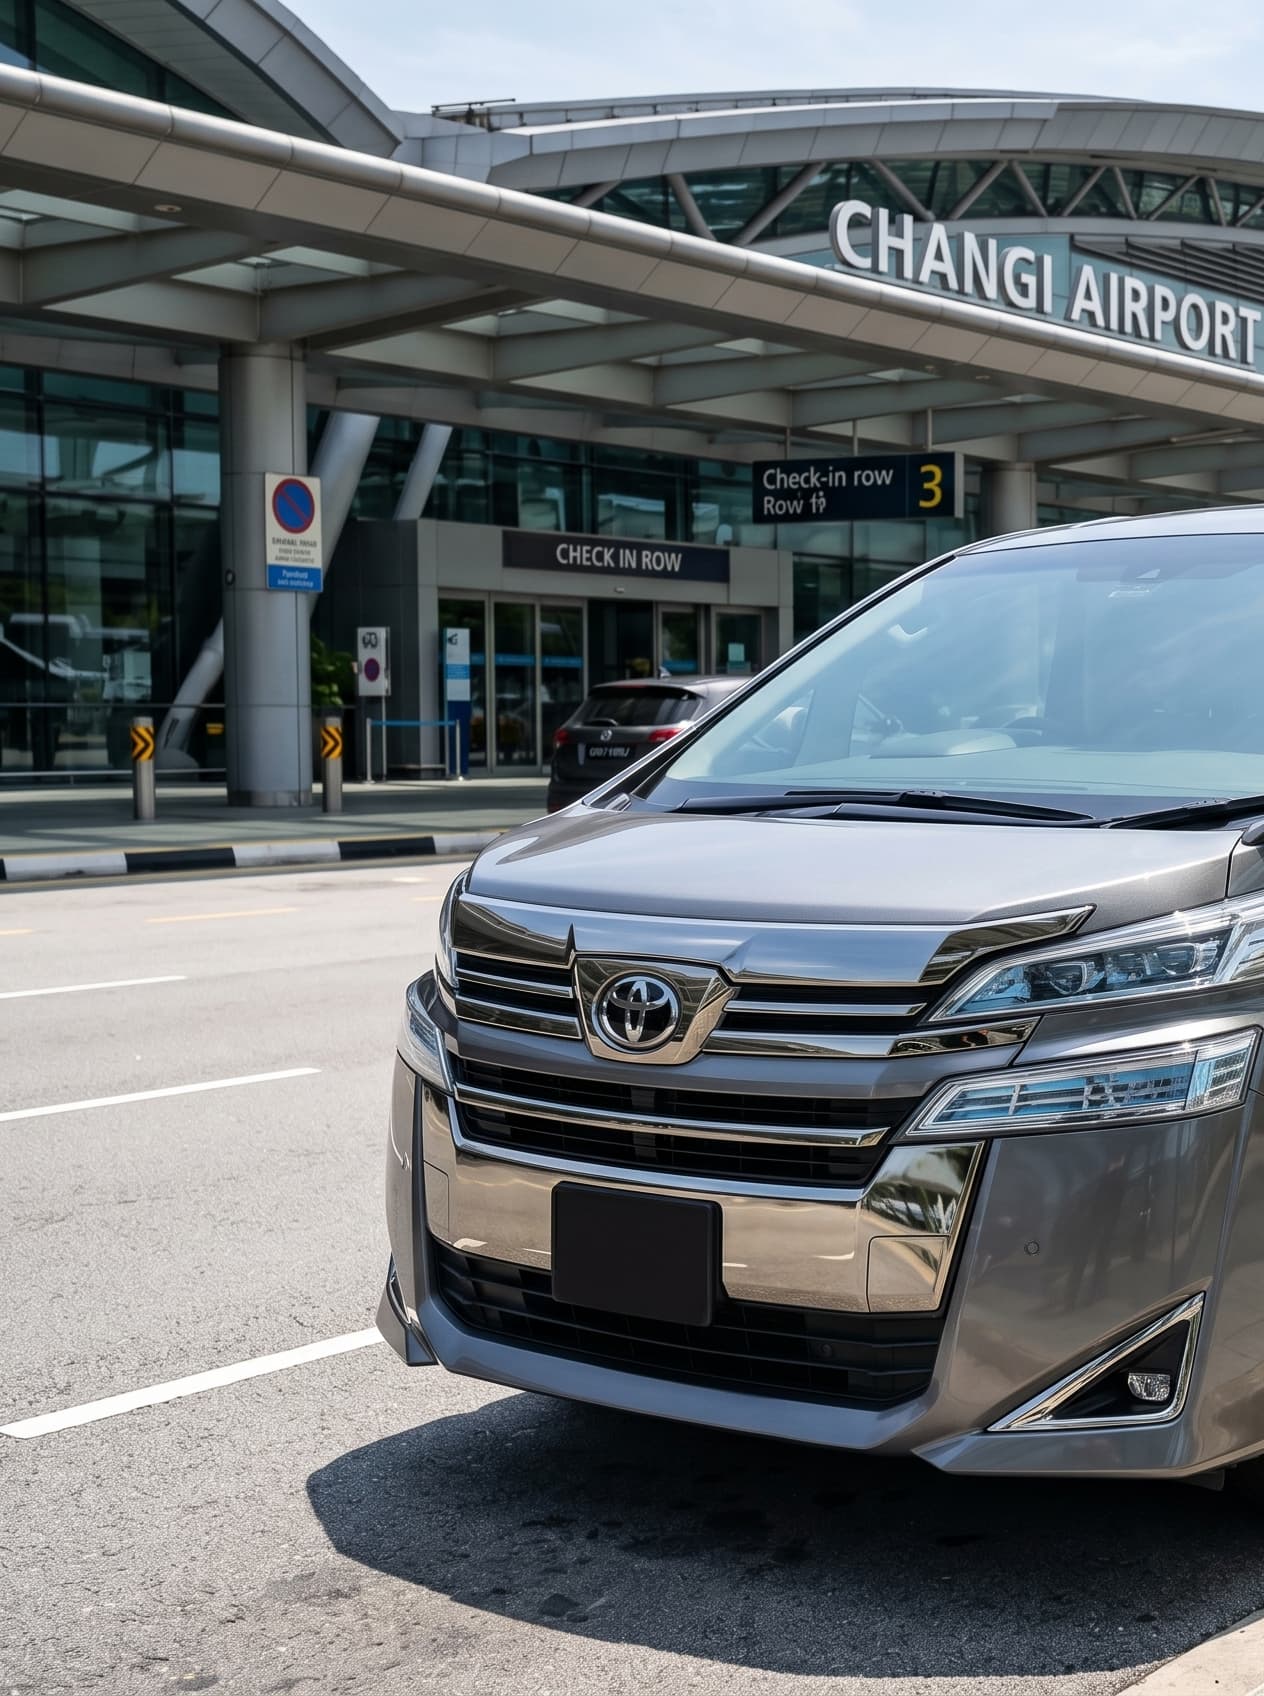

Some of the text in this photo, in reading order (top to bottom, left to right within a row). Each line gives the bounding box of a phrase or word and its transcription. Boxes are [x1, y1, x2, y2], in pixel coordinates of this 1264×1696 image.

[829, 200, 1262, 365] CHANGI AIRPORT
[763, 464, 943, 509] Check-in row 3
[763, 496, 803, 516] Row
[556, 543, 682, 572] CHECK IN ROW
